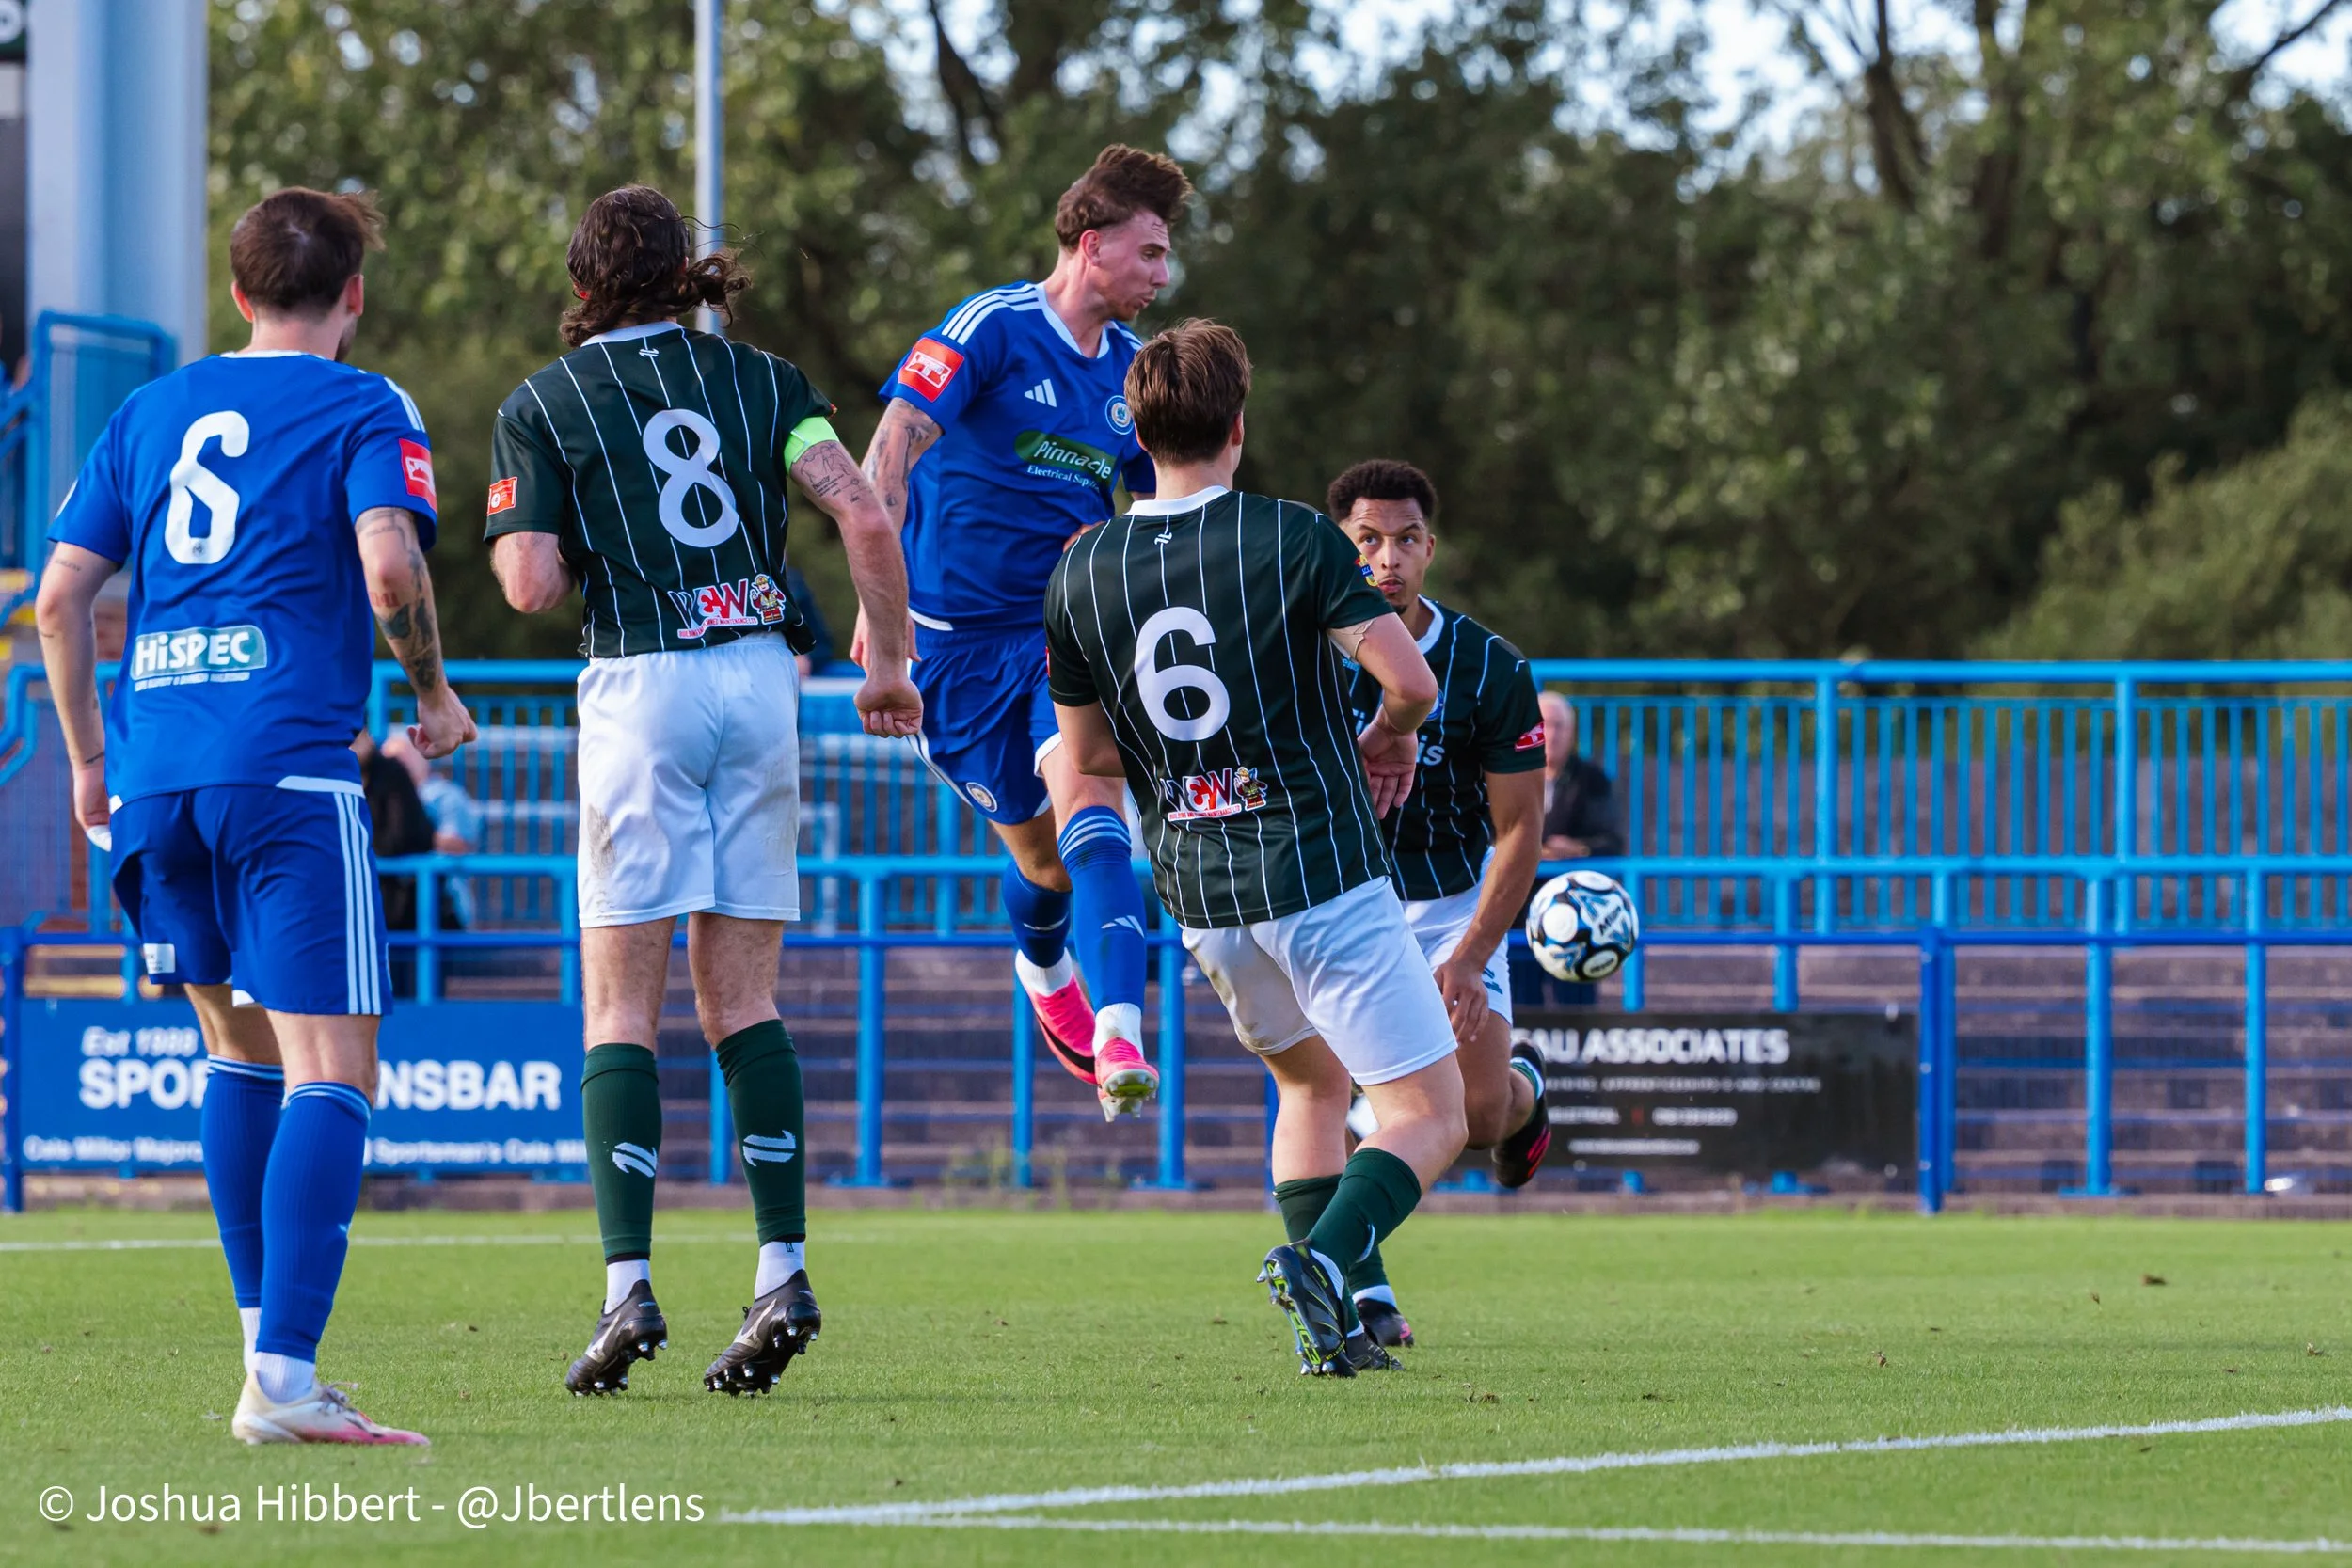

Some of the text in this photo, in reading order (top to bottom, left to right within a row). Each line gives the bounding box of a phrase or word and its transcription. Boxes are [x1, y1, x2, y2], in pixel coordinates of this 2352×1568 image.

[642, 409, 739, 549] 8
[1026, 465, 1073, 482] Electrical
[1033, 440, 1112, 479] Pinnacle
[165, 410, 250, 564] 6
[135, 631, 251, 677] HiSPEC
[1135, 606, 1230, 742] 6
[81, 1026, 131, 1057] Est
[1581, 1027, 1790, 1064] ASSOCIATES
